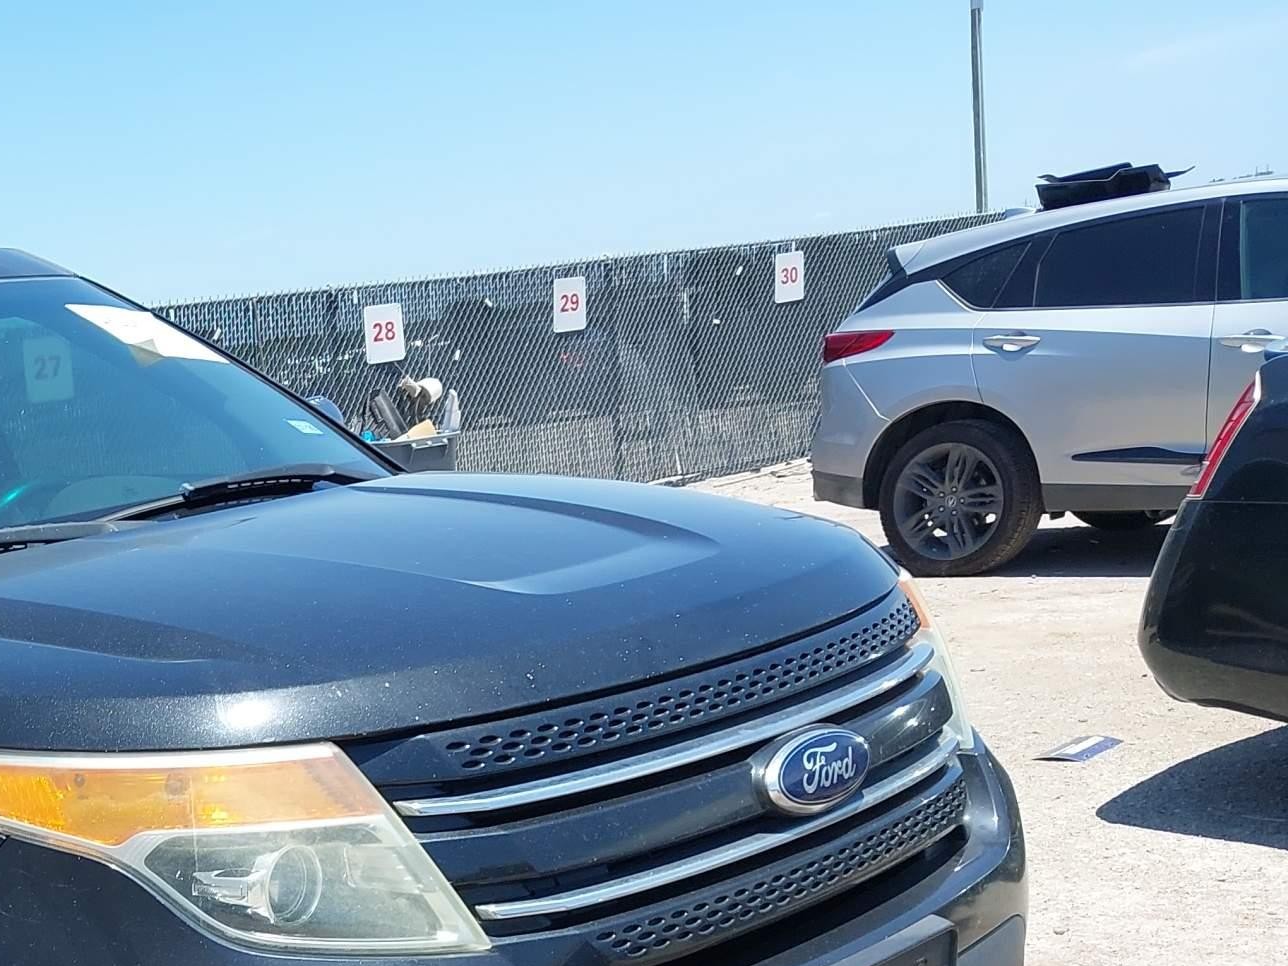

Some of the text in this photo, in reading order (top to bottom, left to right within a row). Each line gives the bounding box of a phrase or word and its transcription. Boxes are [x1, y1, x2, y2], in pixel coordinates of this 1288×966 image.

[780, 266, 799, 285] 30
[559, 292, 580, 313] 29
[372, 321, 396, 342] 28
[33, 354, 62, 381] 27
[802, 741, 857, 794] Ford
